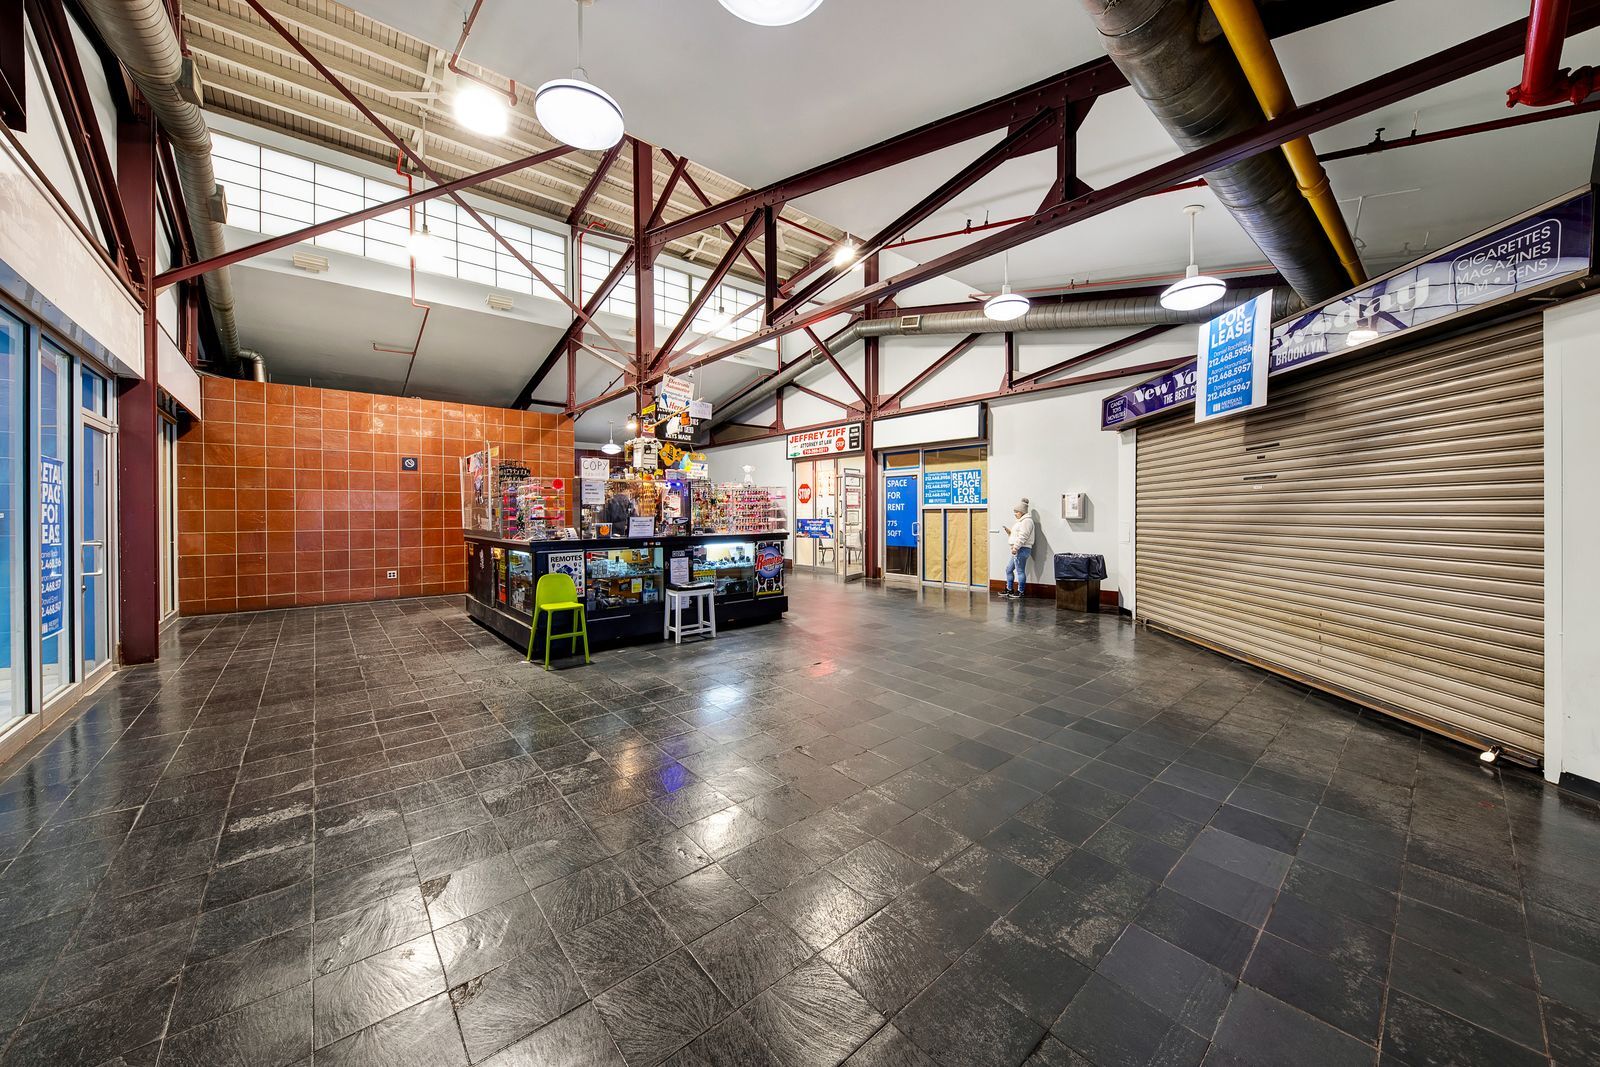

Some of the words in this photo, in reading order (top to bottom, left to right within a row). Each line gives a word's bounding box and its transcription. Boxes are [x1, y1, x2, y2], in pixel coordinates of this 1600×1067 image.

[1457, 226, 1551, 271] CIGARETTES
[1455, 241, 1551, 284] MAGAZINES
[1456, 279, 1488, 298] FILM
[1507, 258, 1548, 281] PENS
[1218, 304, 1246, 330] FOR
[1211, 316, 1252, 349] LEASE
[1208, 343, 1252, 369] 212.468.5956
[1213, 346, 1227, 358] Daniel
[1207, 362, 1252, 386] 212.468.5957
[1211, 365, 1223, 375] Aaron
[1132, 380, 1171, 405] New
[1207, 381, 1251, 402] 212.468.5947
[1213, 381, 1227, 392] David
[1163, 392, 1174, 405] THE
[1175, 387, 1189, 402] BEST
[1220, 396, 1242, 407] MERIDIAN
[669, 401, 685, 412] Here
[1110, 399, 1125, 409] CANDY
[789, 431, 825, 444] JEFFREY
[826, 427, 847, 438] ZIFF
[582, 459, 608, 471] COPY
[952, 471, 981, 481] RETAIL
[887, 479, 908, 488] SPACE
[952, 479, 980, 489] SPACE
[797, 488, 811, 500] STOP
[887, 491, 901, 500] FOR
[957, 487, 975, 496] FOR
[953, 495, 980, 504] LEASE
[887, 503, 905, 511] RENT
[887, 529, 902, 538] SQFT
[550, 554, 583, 563] REMOTES
[755, 553, 784, 571] Remotes
